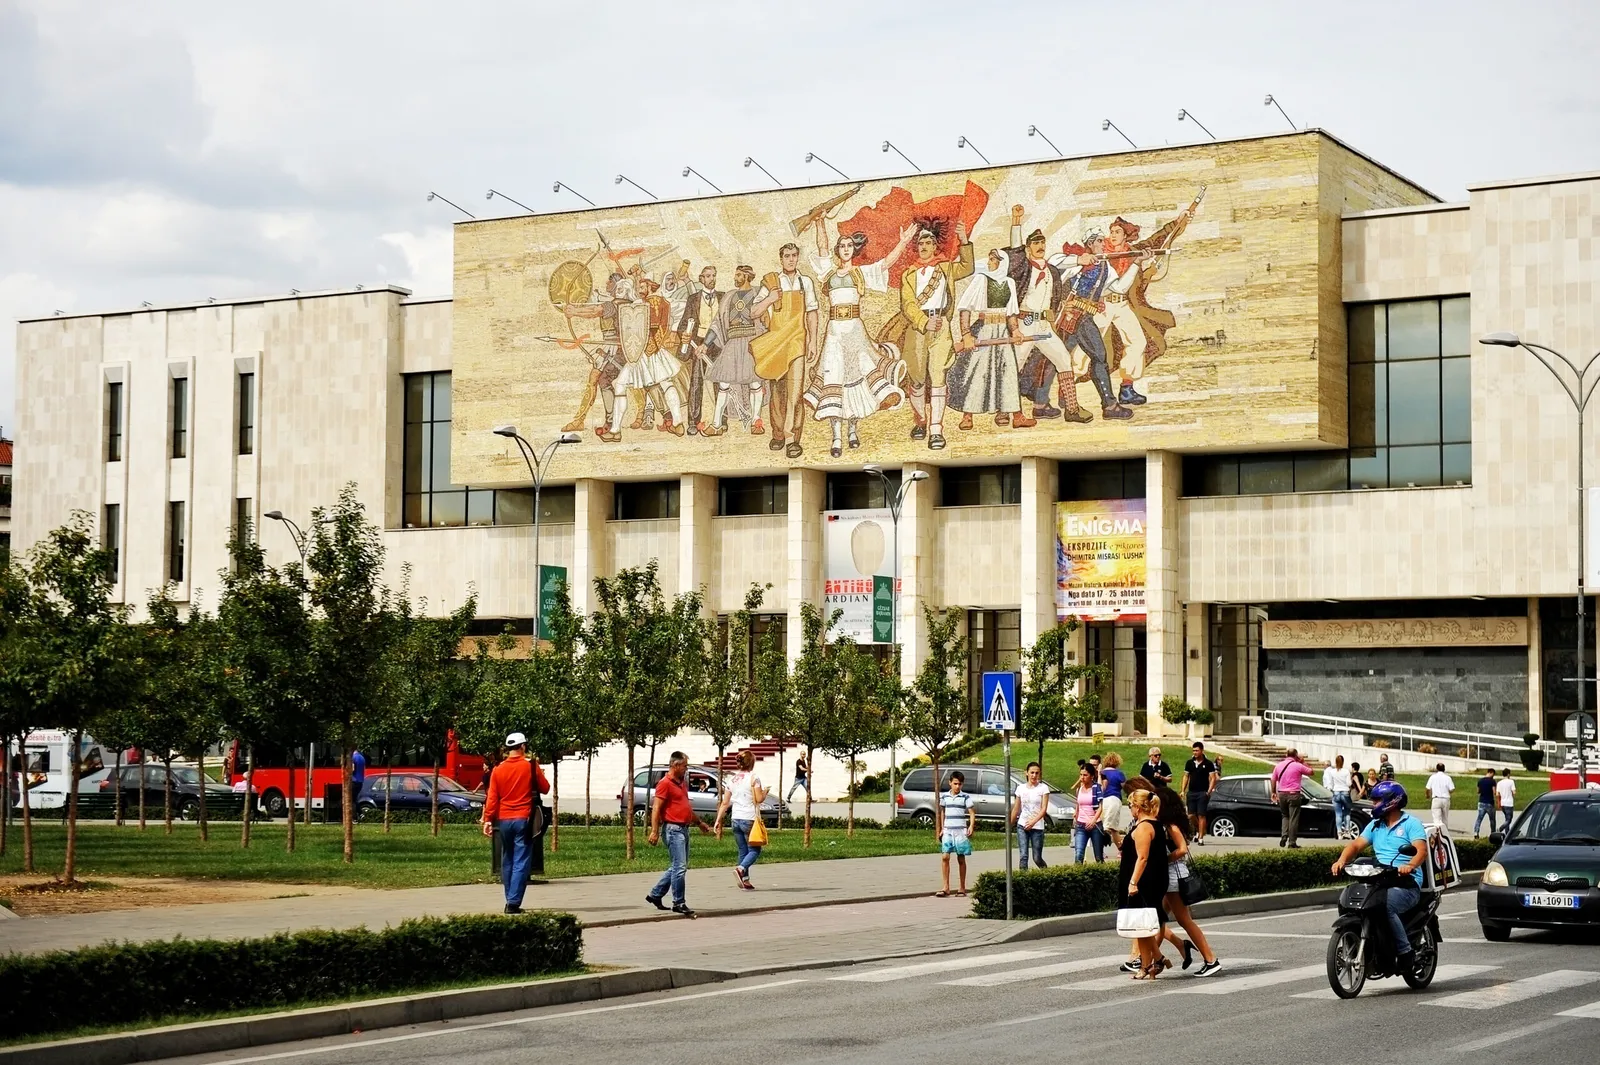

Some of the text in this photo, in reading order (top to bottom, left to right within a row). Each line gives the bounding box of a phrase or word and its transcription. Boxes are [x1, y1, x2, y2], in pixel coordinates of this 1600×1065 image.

[1067, 541, 1107, 551] EKSPOZITE
[1067, 553, 1096, 561] DHIMITRA
[1097, 552, 1120, 560] MISRASI
[825, 594, 869, 603] ARDIAN
[1068, 590, 1080, 599] Nga
[1081, 590, 1096, 598] data
[1097, 589, 1104, 597] 17
[1109, 589, 1117, 597] 25
[1120, 589, 1145, 597] shtator
